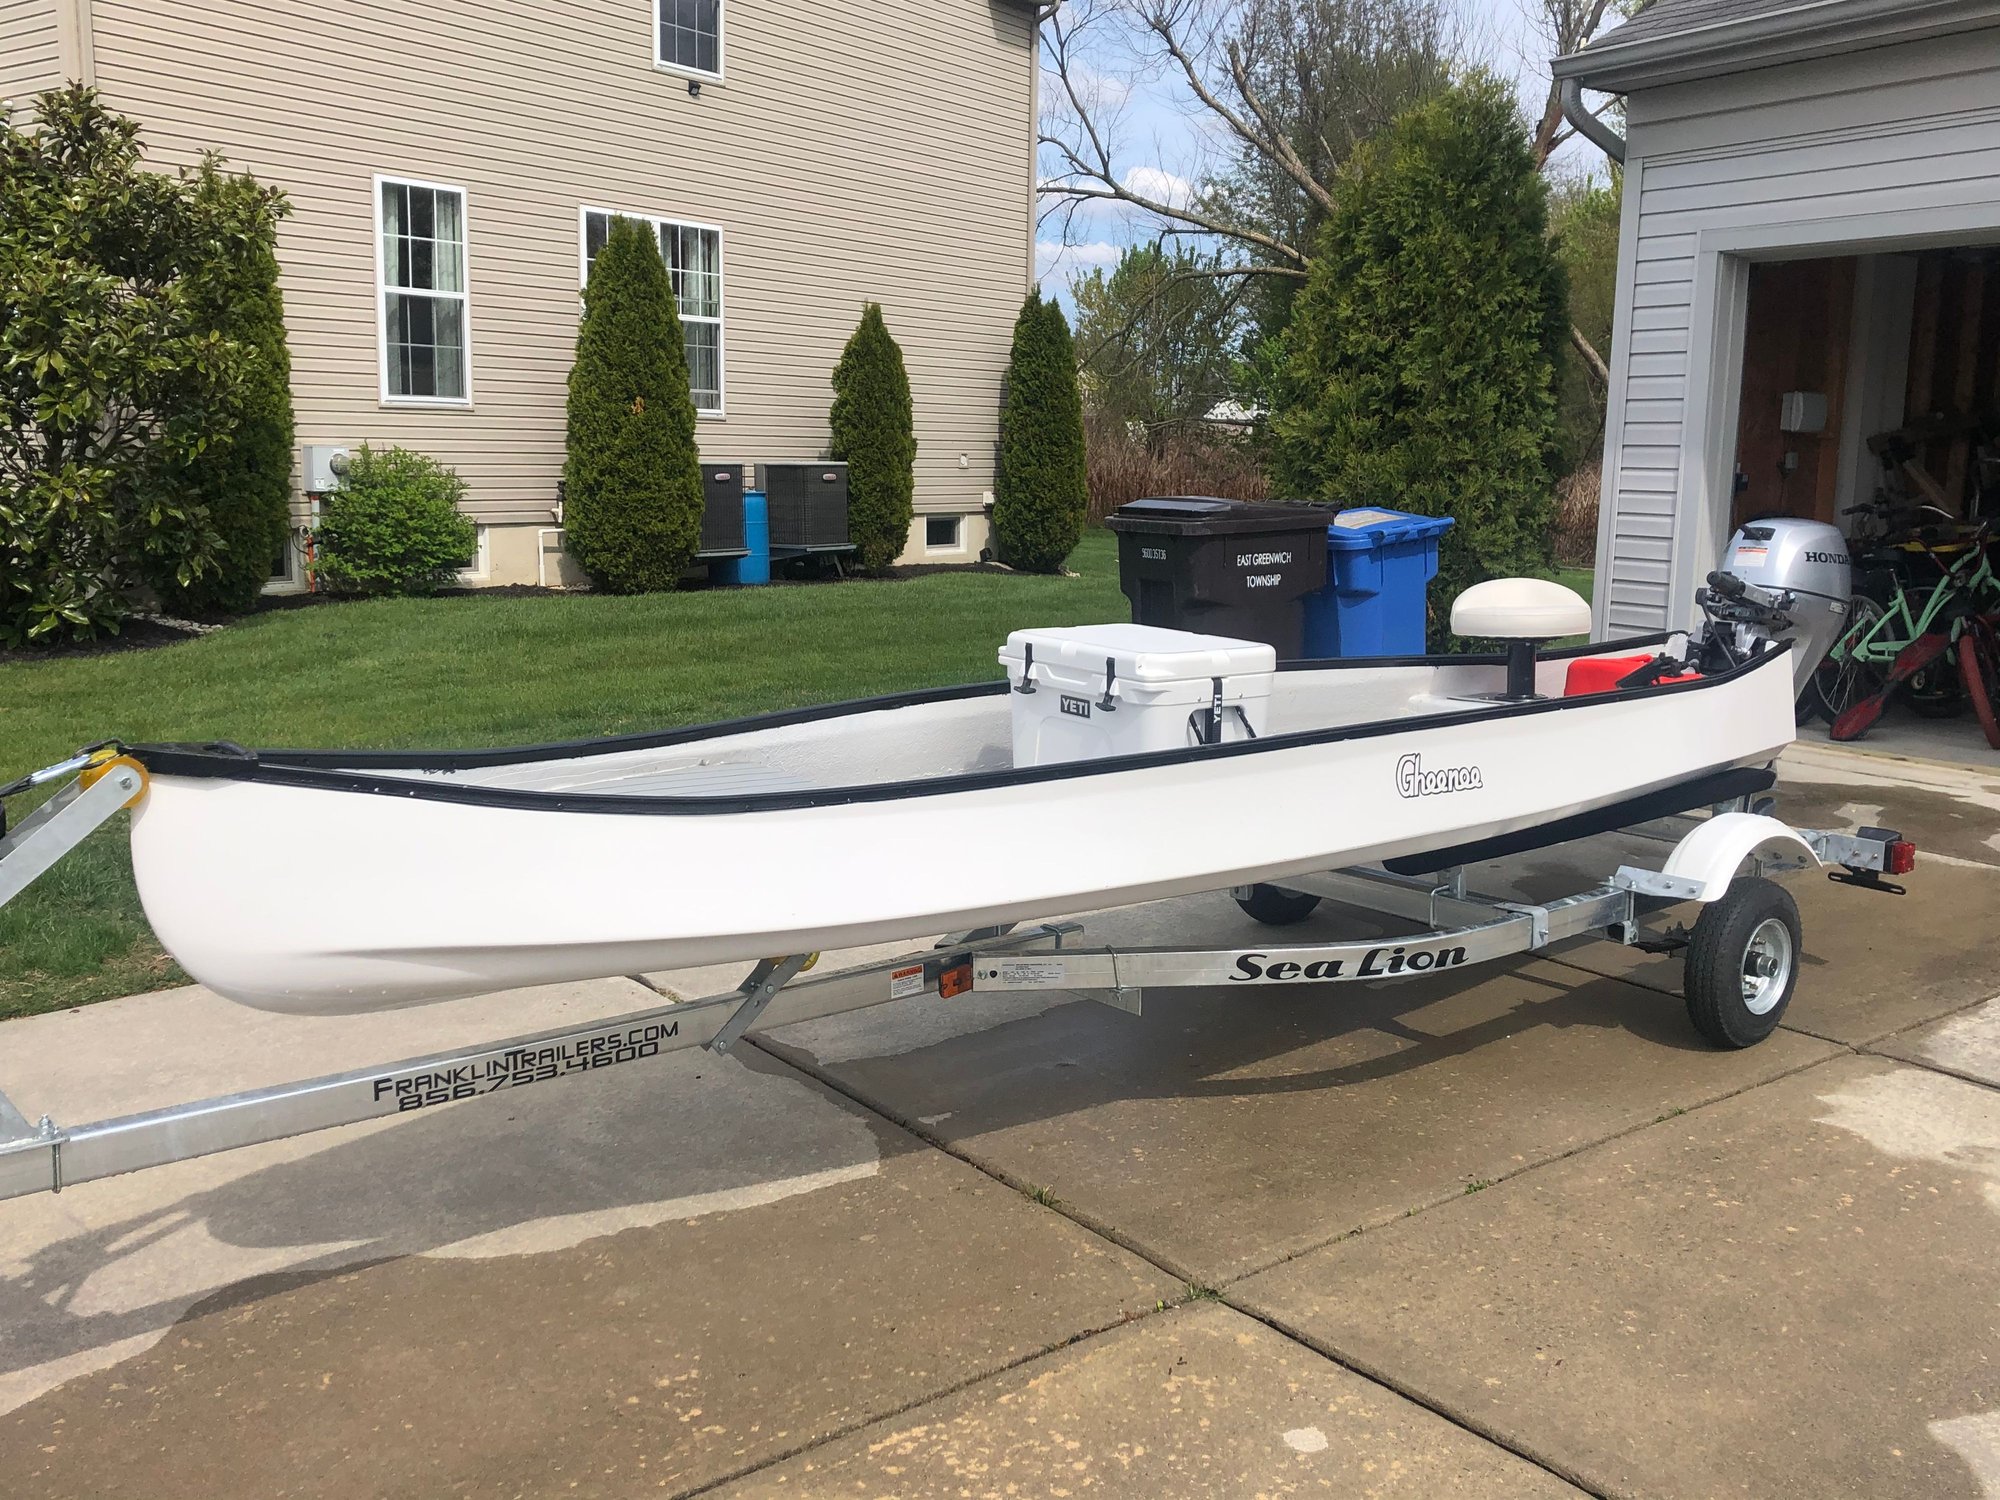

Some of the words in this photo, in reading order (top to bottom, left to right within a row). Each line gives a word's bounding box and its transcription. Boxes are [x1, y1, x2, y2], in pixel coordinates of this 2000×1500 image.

[1237, 554, 1252, 566] EAST
[1252, 551, 1292, 565] GREENWICH
[1804, 551, 1850, 565] HONDA
[1246, 573, 1282, 588] TOWNSHIP
[1061, 697, 1088, 715] YETI
[1213, 694, 1222, 724] YETI
[1396, 753, 1483, 798] Gheenoe
[1228, 953, 1344, 981] Sea
[1356, 946, 1469, 977] Lion
[373, 1021, 679, 1102] FRANKLINTRAILERS.COM
[398, 1042, 659, 1112] 856.753.4600
